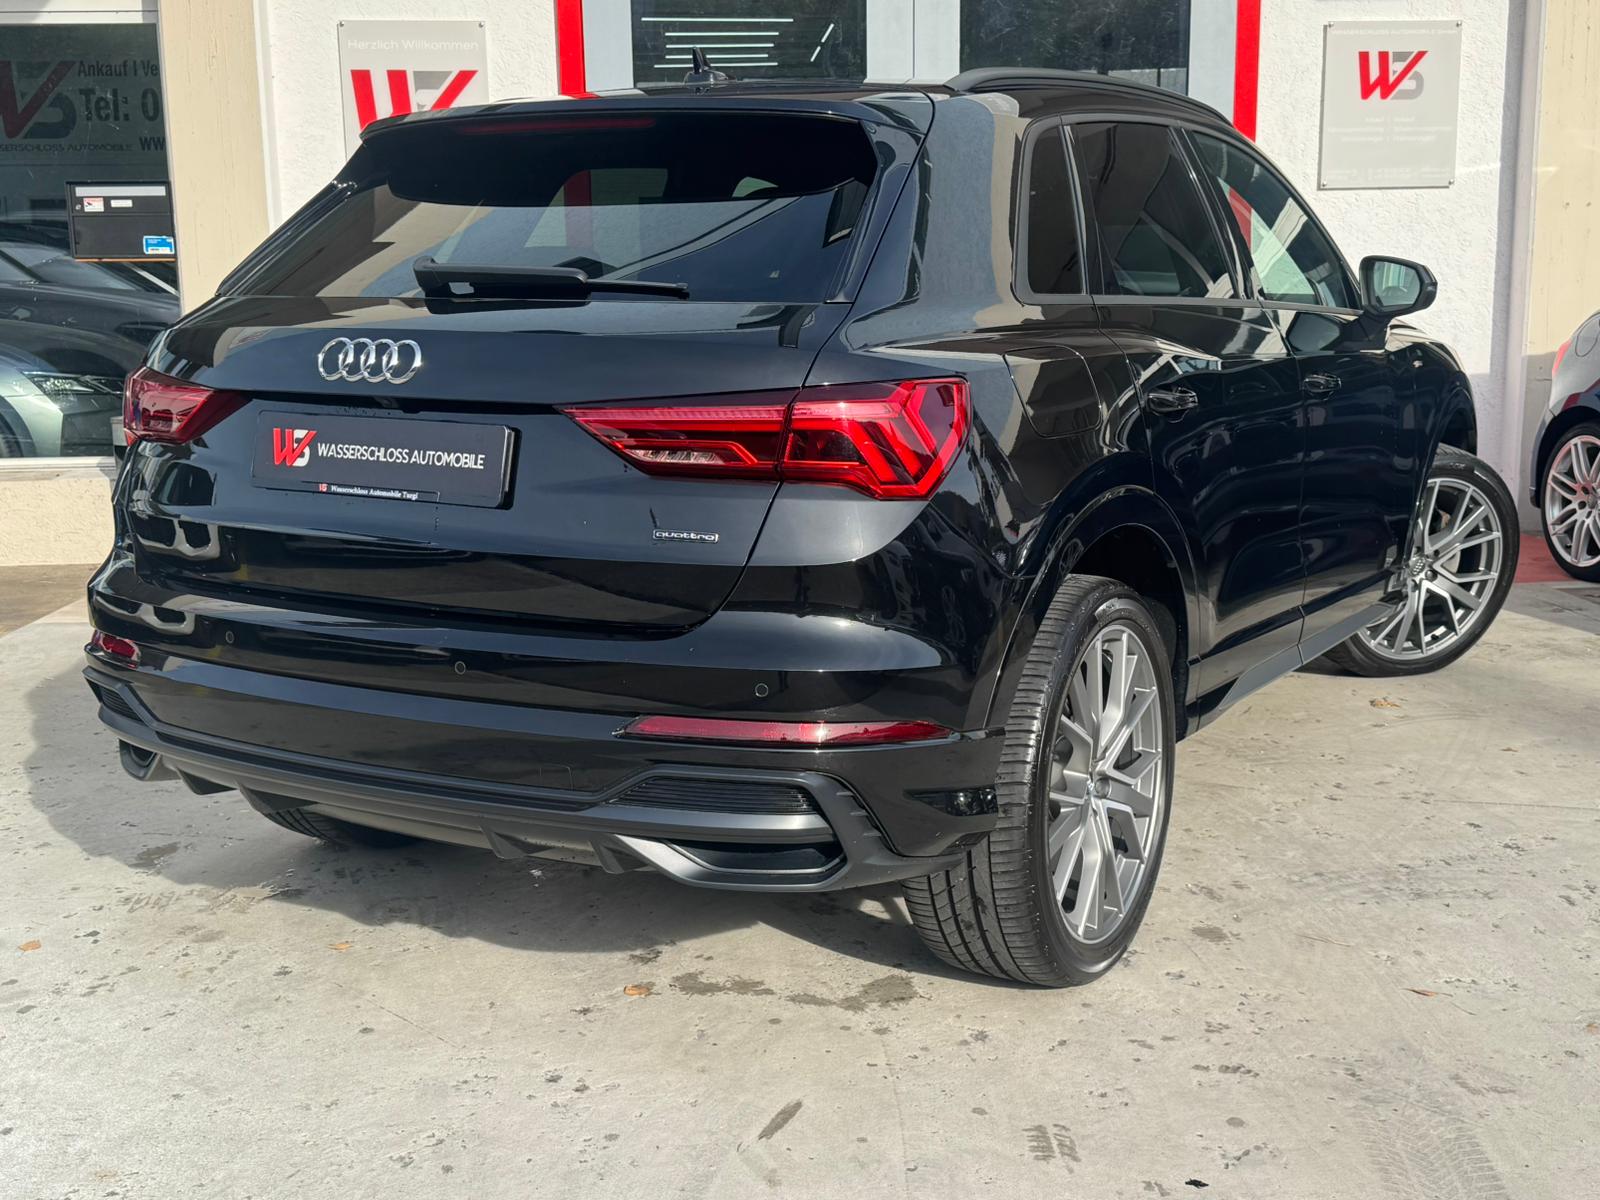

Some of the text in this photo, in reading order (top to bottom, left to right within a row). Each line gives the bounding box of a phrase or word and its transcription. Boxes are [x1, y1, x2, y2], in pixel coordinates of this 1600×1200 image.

[347, 39, 479, 50] Herzlich Willkommen
[77, 60, 129, 77] Ankauf
[79, 87, 160, 122] Tel: 0
[317, 442, 486, 469] WASSERSCHLOSS AUTOMOBILE
[331, 485, 419, 501] Wasserschloss Automobile Turgi
[655, 531, 716, 541] quattro
